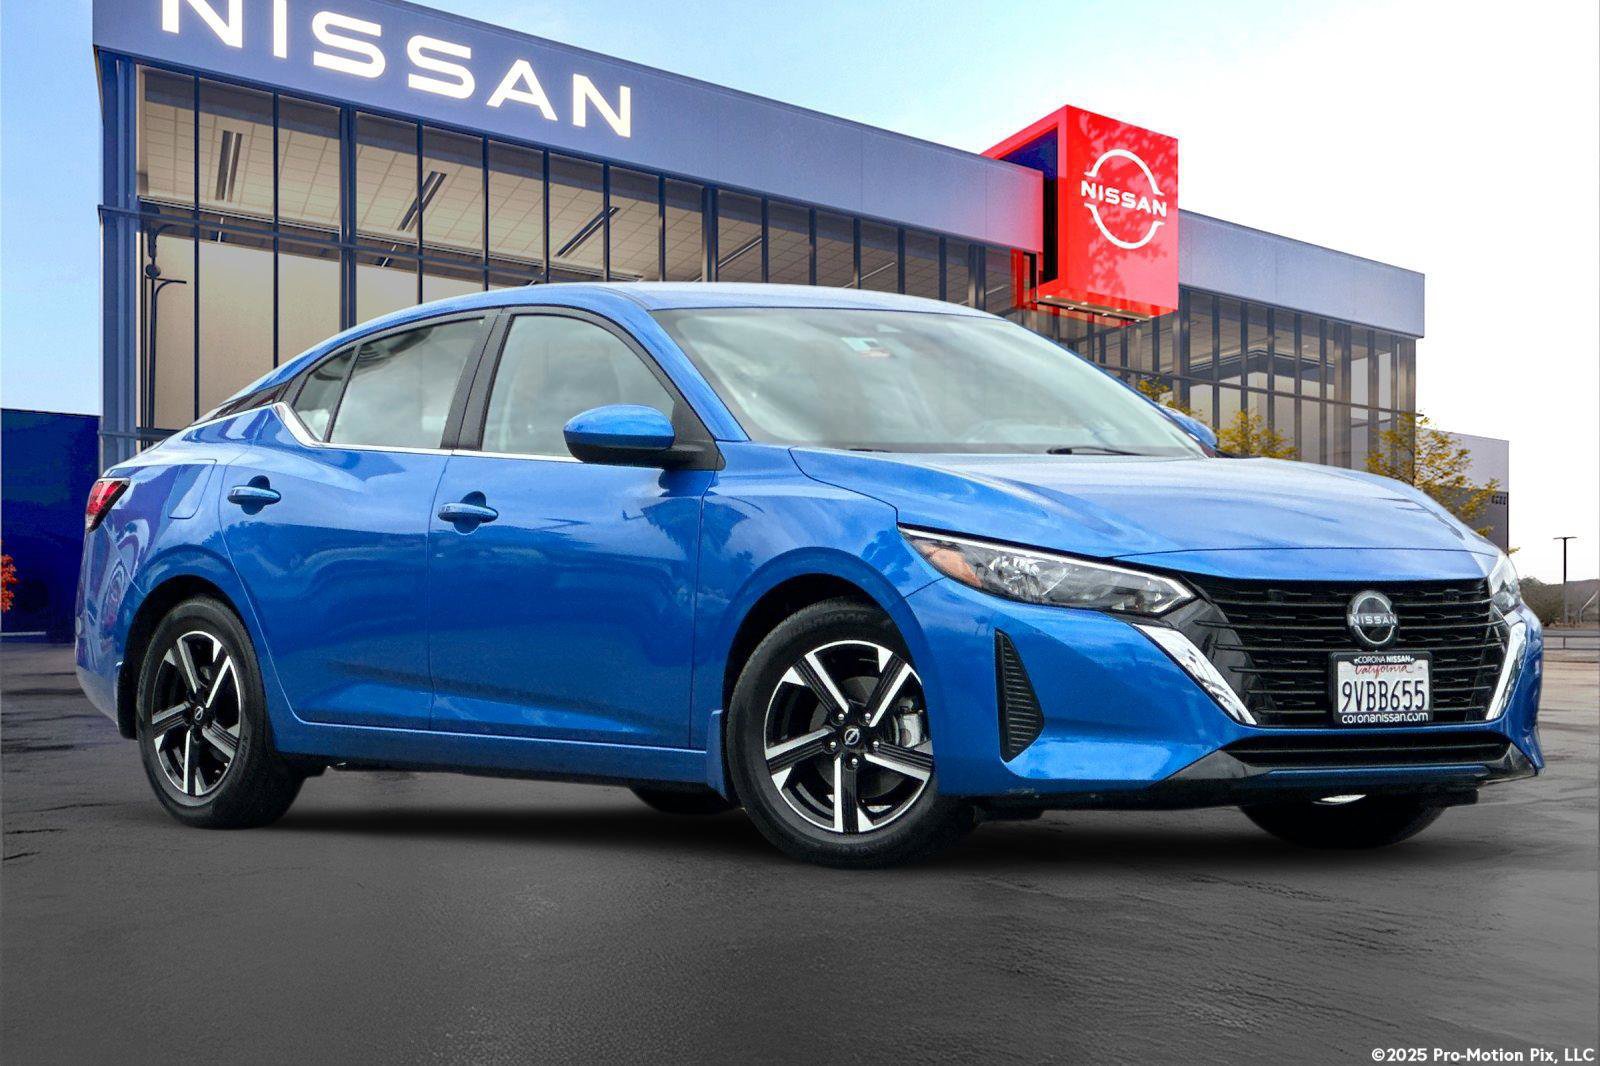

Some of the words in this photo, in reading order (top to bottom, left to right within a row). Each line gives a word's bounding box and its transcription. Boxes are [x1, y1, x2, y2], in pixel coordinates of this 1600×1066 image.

[1081, 180, 1167, 217] NISSAN
[1350, 615, 1397, 625] NISSAN
[1358, 656, 1385, 664] CORONA
[1386, 655, 1411, 663] NISSAN
[1355, 664, 1414, 679] California
[1342, 680, 1425, 712] 9VBB655
[1341, 712, 1428, 724] coronanissan.com
